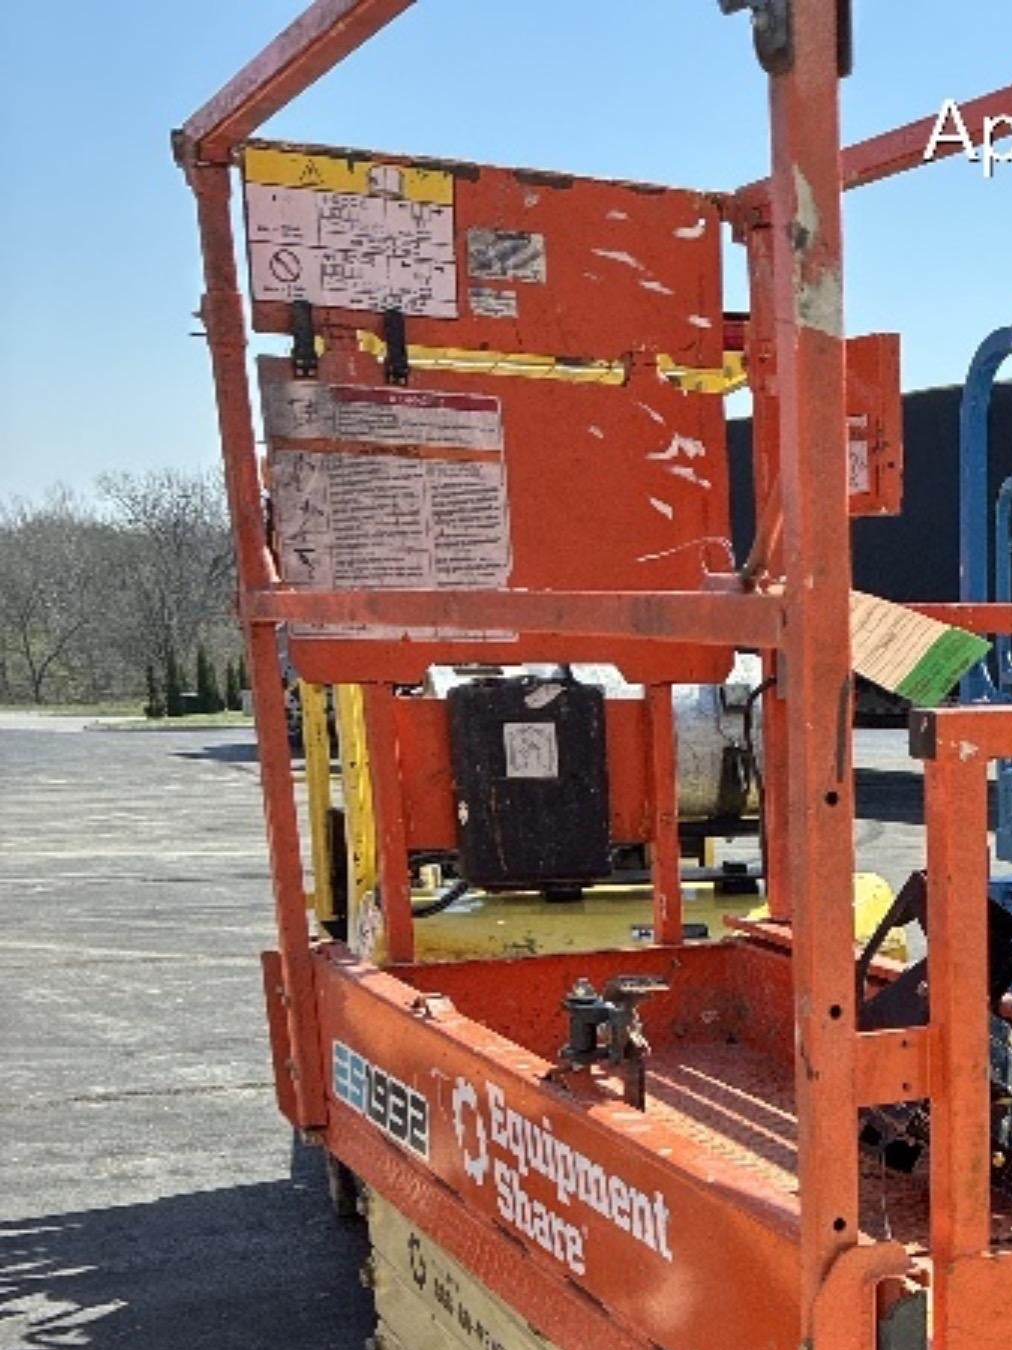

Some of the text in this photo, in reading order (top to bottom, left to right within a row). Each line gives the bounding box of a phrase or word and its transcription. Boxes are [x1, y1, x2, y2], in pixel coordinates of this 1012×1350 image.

[333, 1039, 430, 1162] ES1932
[485, 1080, 673, 1263] Equipment
[493, 1157, 587, 1276] Share
